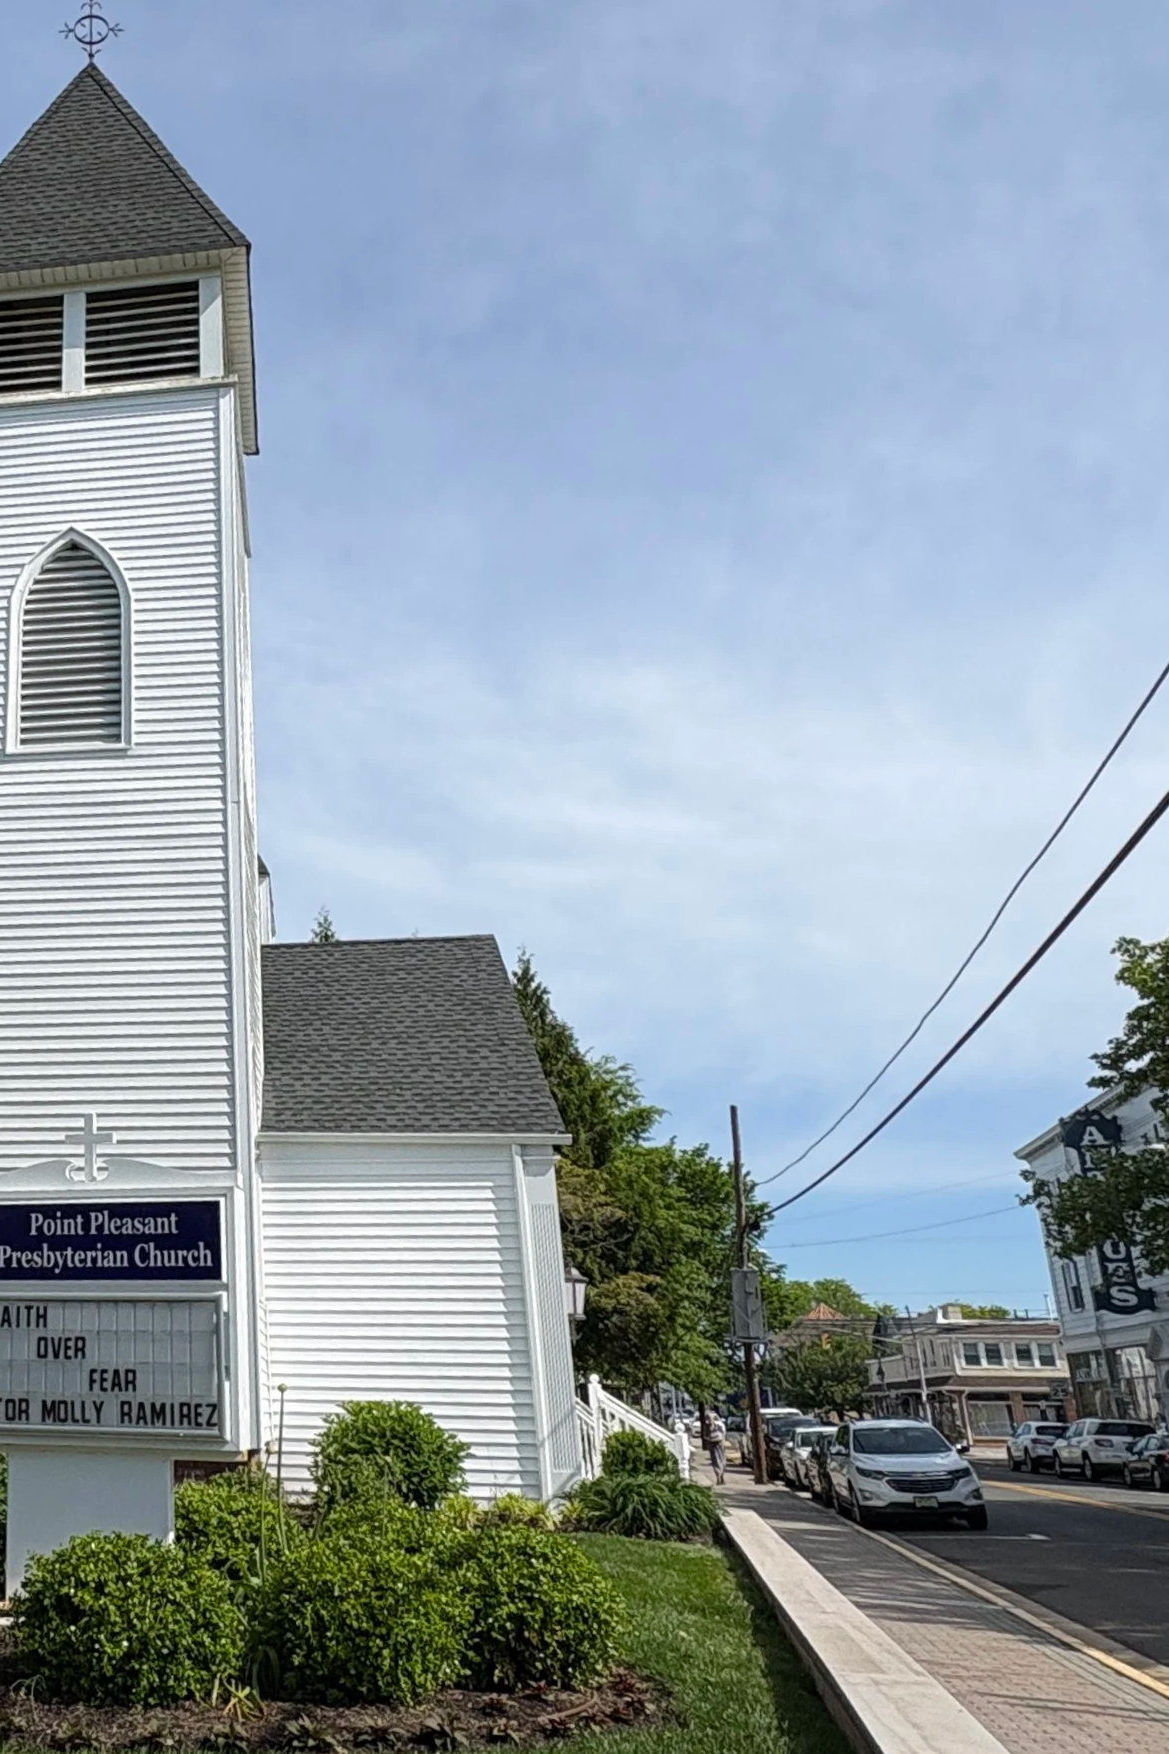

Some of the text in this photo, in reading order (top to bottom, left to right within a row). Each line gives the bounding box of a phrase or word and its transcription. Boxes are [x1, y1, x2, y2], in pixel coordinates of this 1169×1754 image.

[29, 1211, 178, 1236] Point Pleasant
[134, 1242, 214, 1268] Church
[37, 1336, 86, 1360] OVER
[89, 1369, 137, 1392] FEAR
[41, 1400, 105, 1424] MOLLY
[120, 1401, 218, 1427] RAMIREZ
